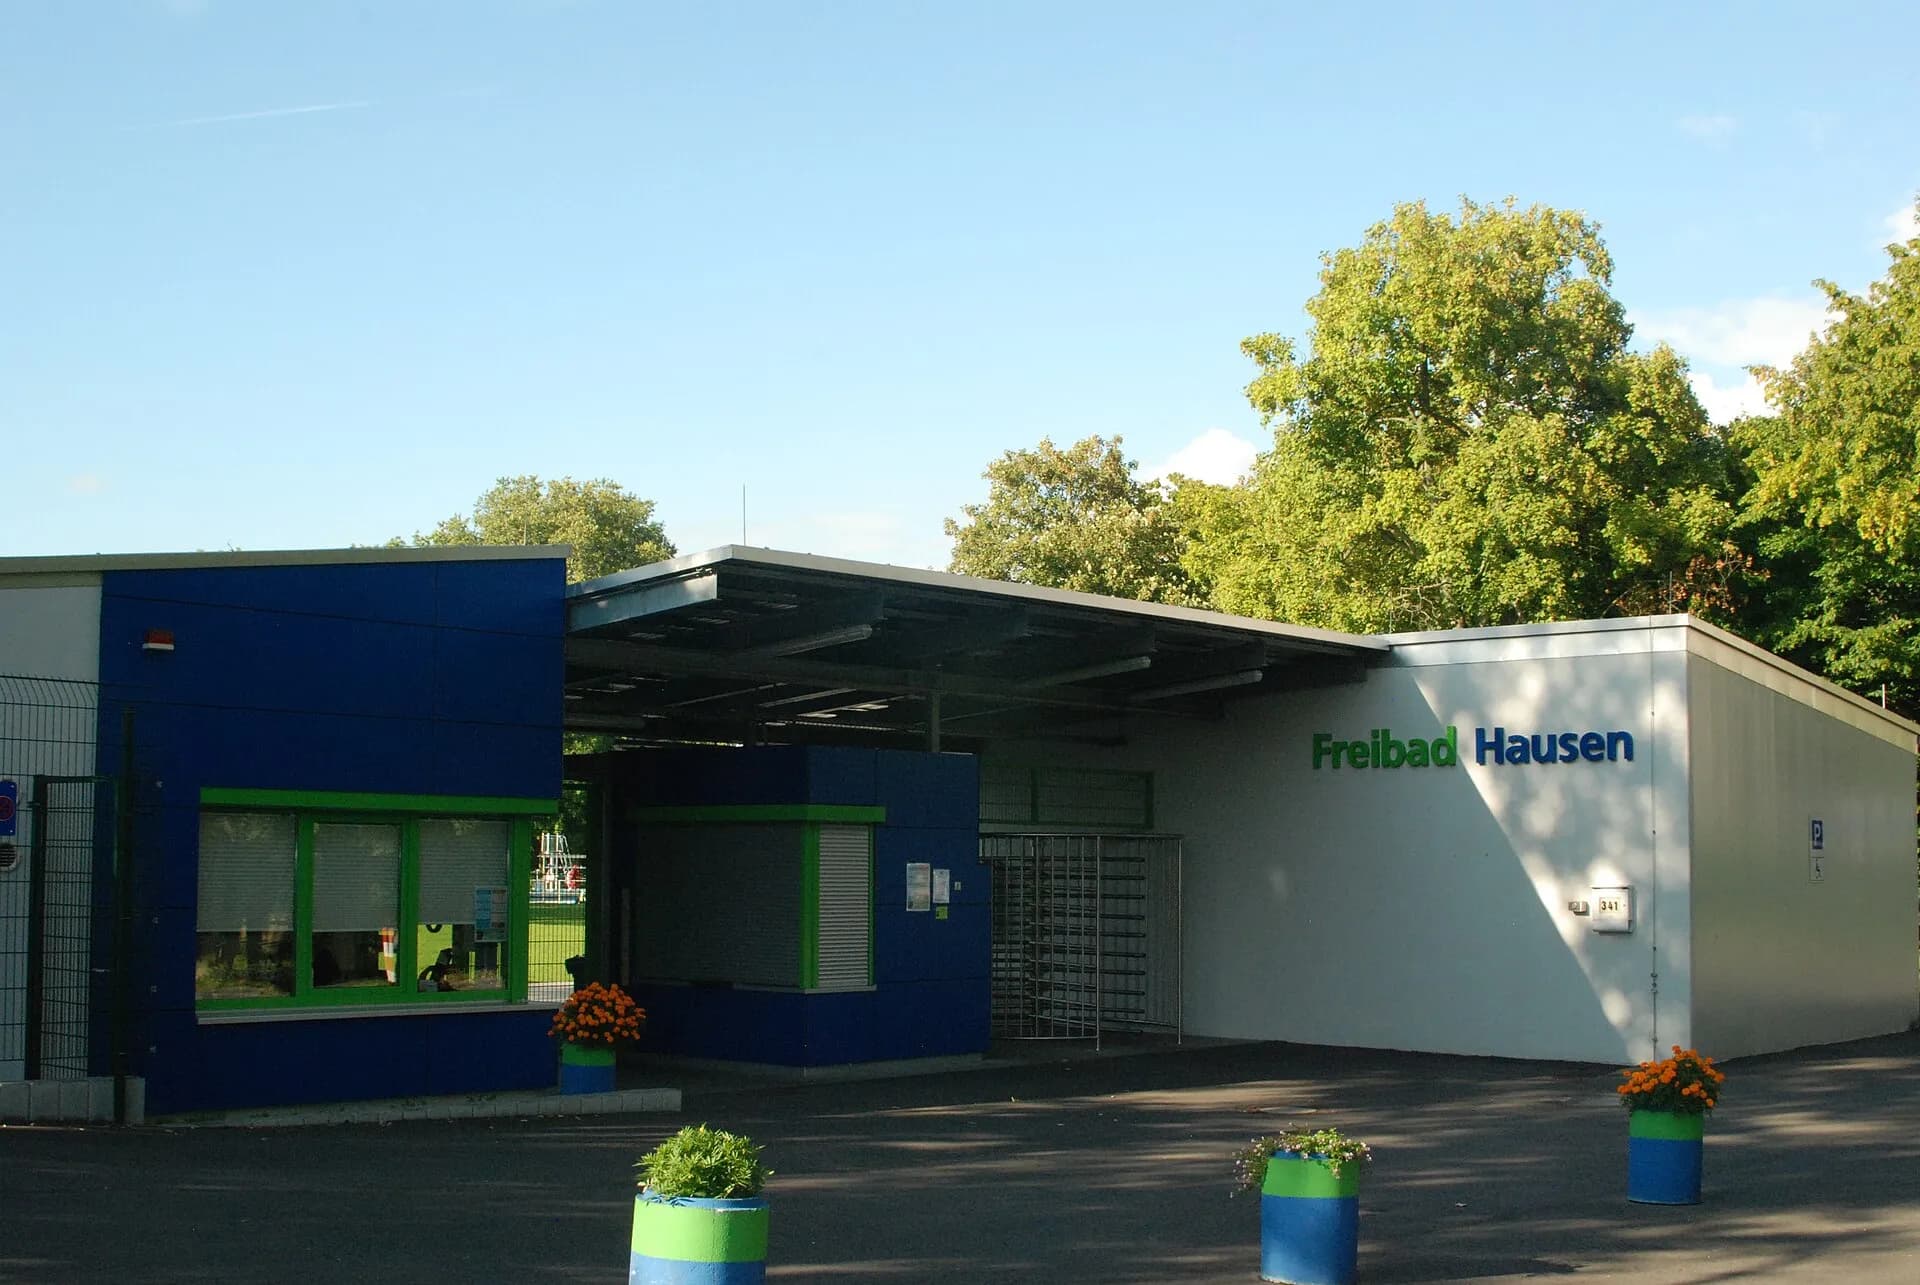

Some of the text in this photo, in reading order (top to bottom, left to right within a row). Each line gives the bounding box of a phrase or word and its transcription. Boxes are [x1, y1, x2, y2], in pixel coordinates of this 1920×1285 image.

[1312, 725, 1635, 769] Freibad Hausen
[1813, 823, 1821, 847] P
[1601, 900, 1619, 911] 341
